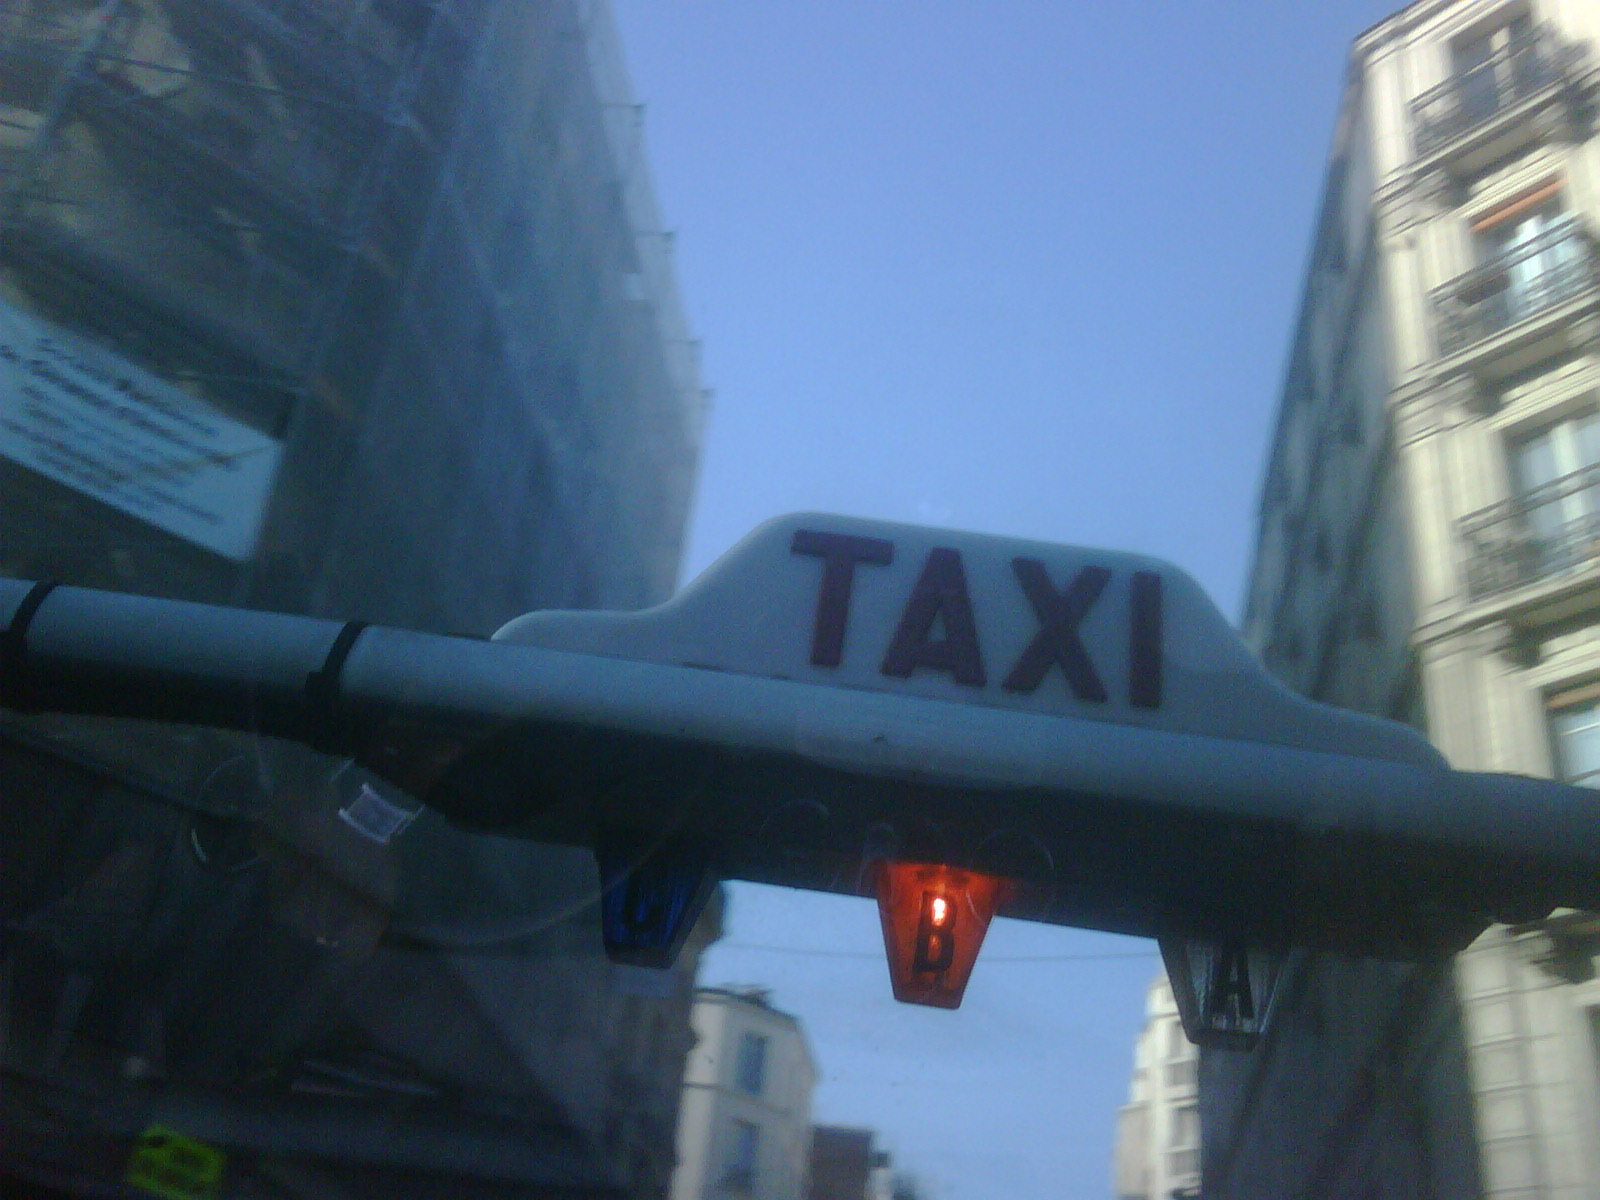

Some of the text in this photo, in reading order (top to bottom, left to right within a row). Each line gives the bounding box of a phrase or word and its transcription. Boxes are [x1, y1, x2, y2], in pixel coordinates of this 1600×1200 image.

[791, 529, 1162, 709] TAXI
[913, 890, 960, 980] B
[1209, 938, 1255, 1019] A
